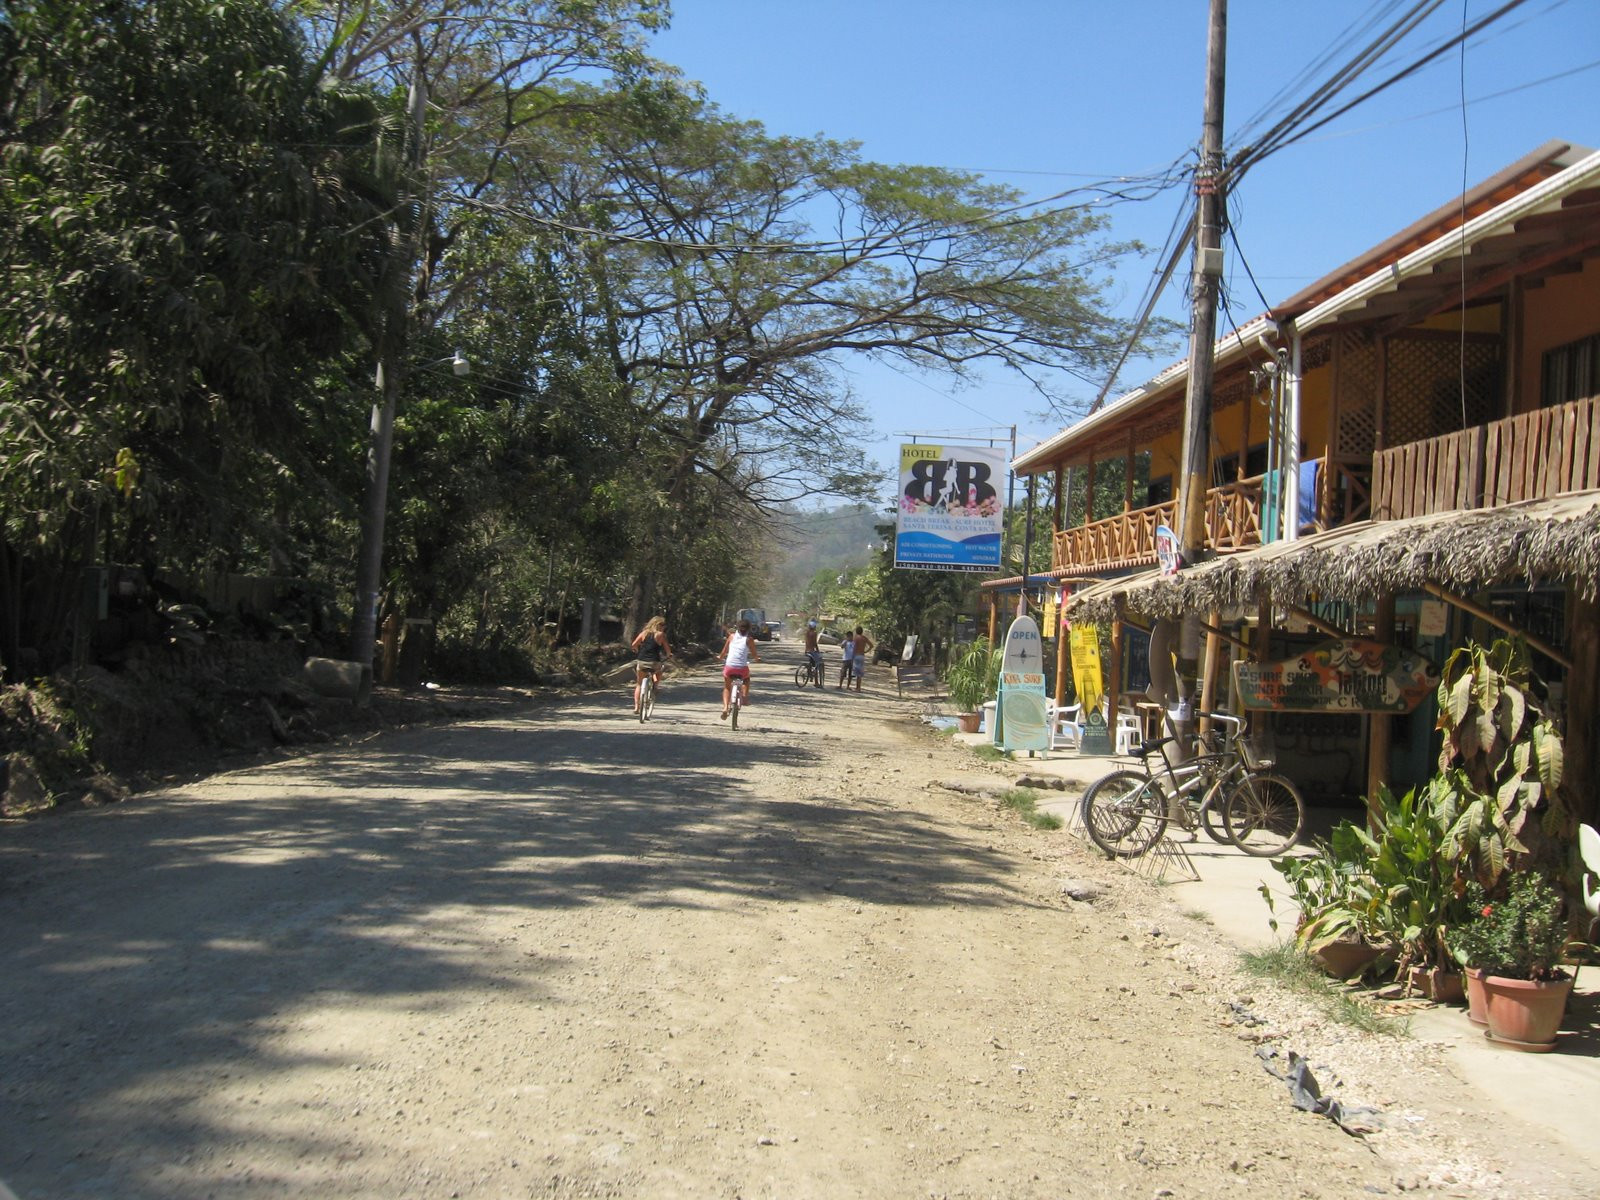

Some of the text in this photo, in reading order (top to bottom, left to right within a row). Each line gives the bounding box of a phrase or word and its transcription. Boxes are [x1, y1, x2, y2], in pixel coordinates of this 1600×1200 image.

[902, 449, 939, 459] HOTEL
[1012, 631, 1037, 640] OPEN
[1024, 674, 1041, 684] SURF
[1249, 672, 1282, 683] SURF
